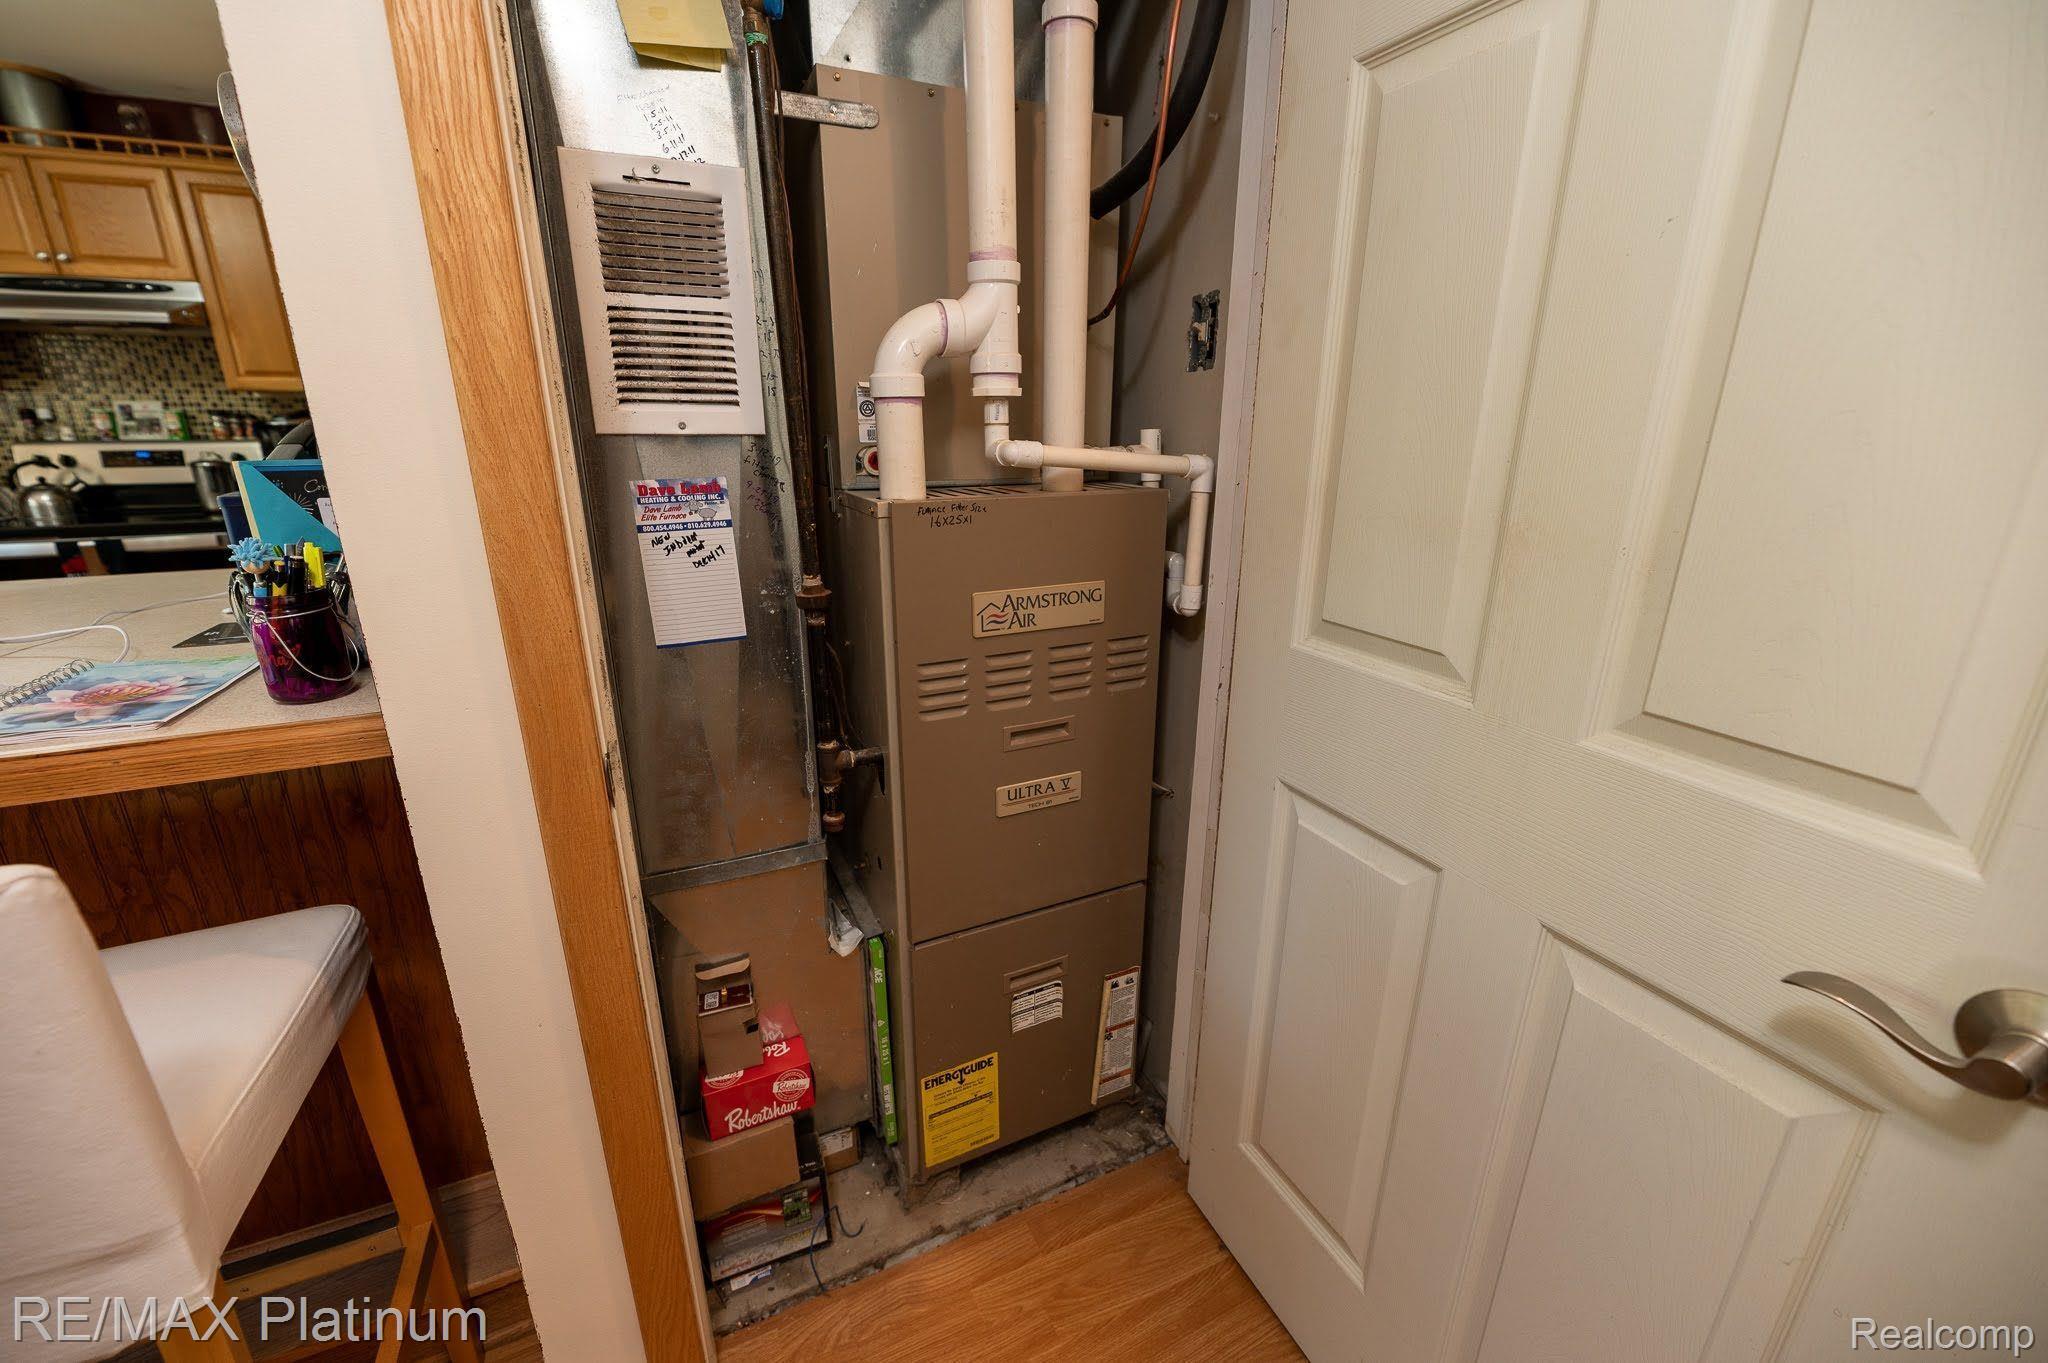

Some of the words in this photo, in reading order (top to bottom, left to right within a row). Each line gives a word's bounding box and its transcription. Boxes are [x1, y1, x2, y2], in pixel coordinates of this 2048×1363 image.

[637, 484, 676, 496] Dave
[680, 478, 721, 494] Lamb
[640, 495, 669, 504] HEATING
[677, 494, 707, 502] COOLING
[643, 505, 661, 513] Dave
[663, 504, 683, 512] Lamb
[659, 512, 687, 521] Furnace
[1001, 587, 1103, 613] ARMSTRONG
[1007, 612, 1037, 630] AIR
[1007, 781, 1056, 802] ULTRA
[1060, 776, 1073, 791] V
[724, 1100, 799, 1134] Robertshaw
